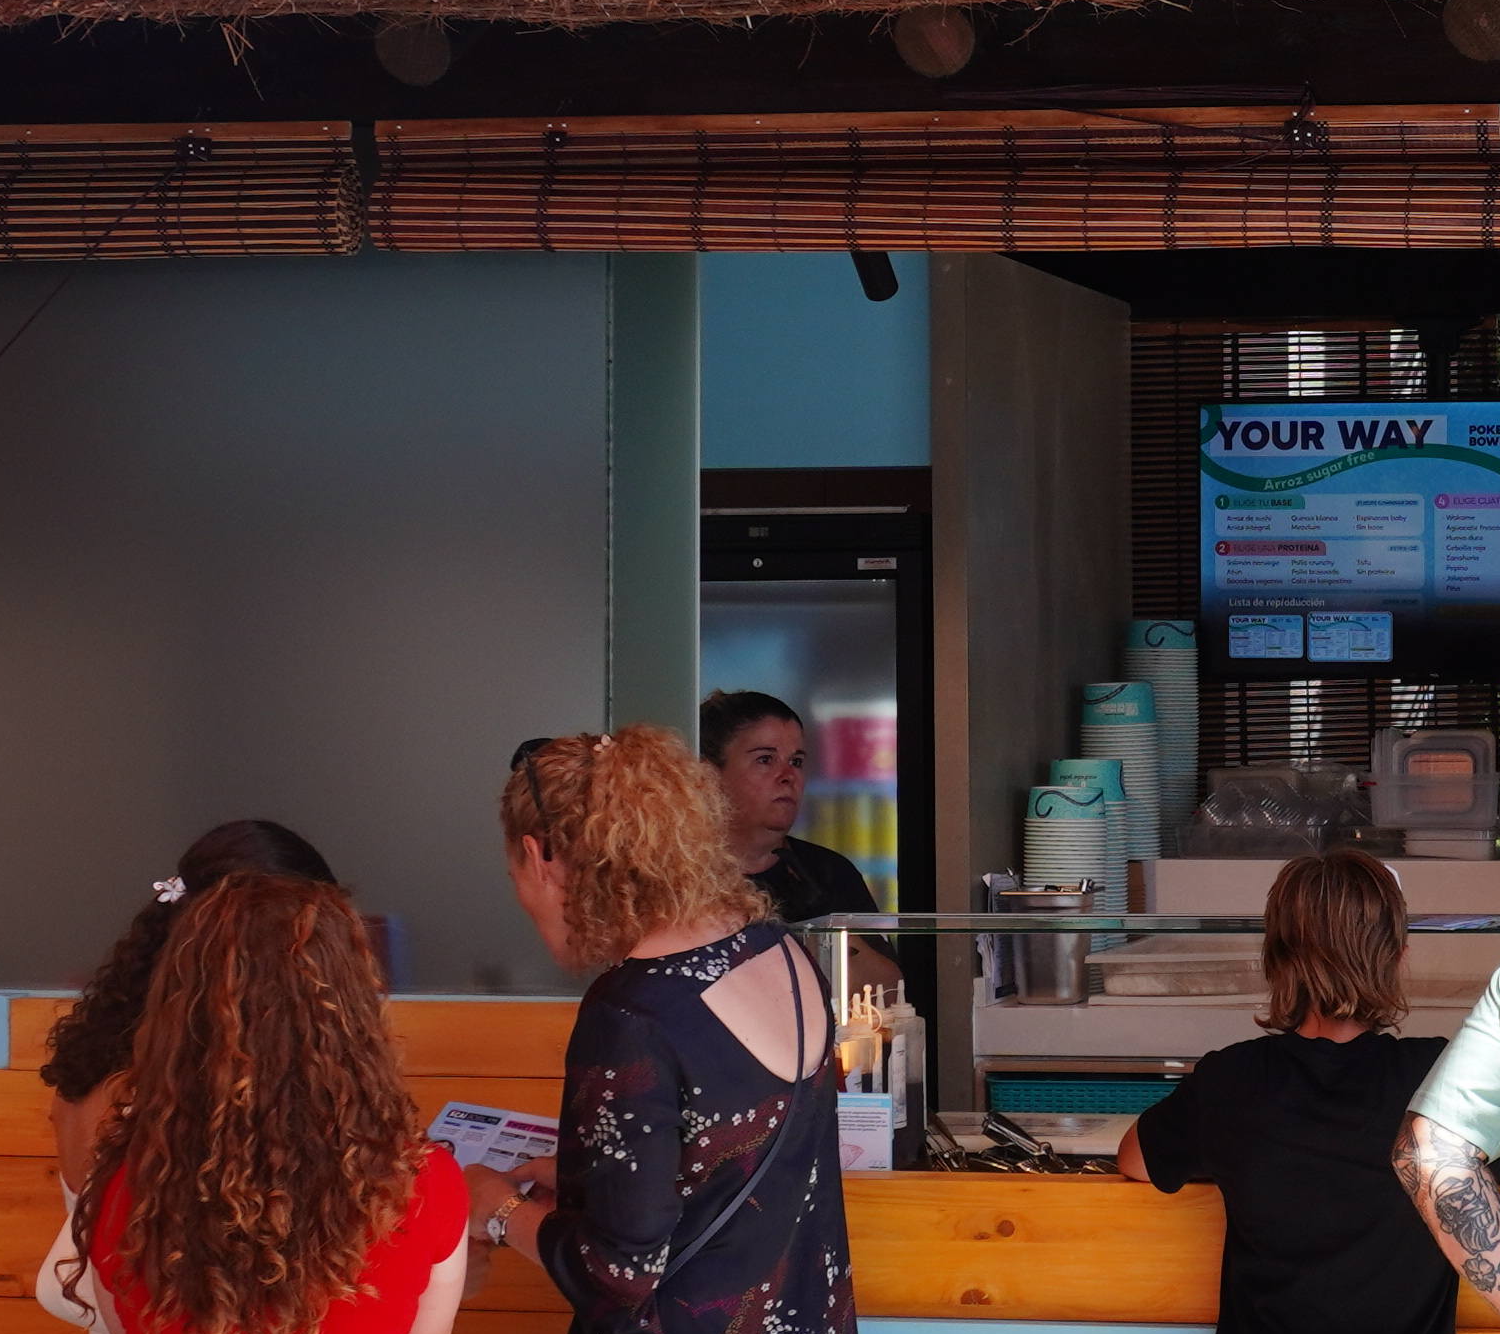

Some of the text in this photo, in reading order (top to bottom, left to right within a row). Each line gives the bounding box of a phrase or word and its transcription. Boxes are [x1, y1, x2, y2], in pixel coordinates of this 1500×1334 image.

[1215, 419, 1434, 451] YOUR WAY
[1263, 451, 1375, 491] Arroz sugar free
[1219, 498, 1225, 507] 1
[1271, 499, 1293, 507] BASE
[1438, 497, 1446, 507] 4
[1218, 544, 1226, 554] 2
[1229, 598, 1325, 609] Lista de reproducción
[1311, 615, 1351, 623] YOUR WAY
